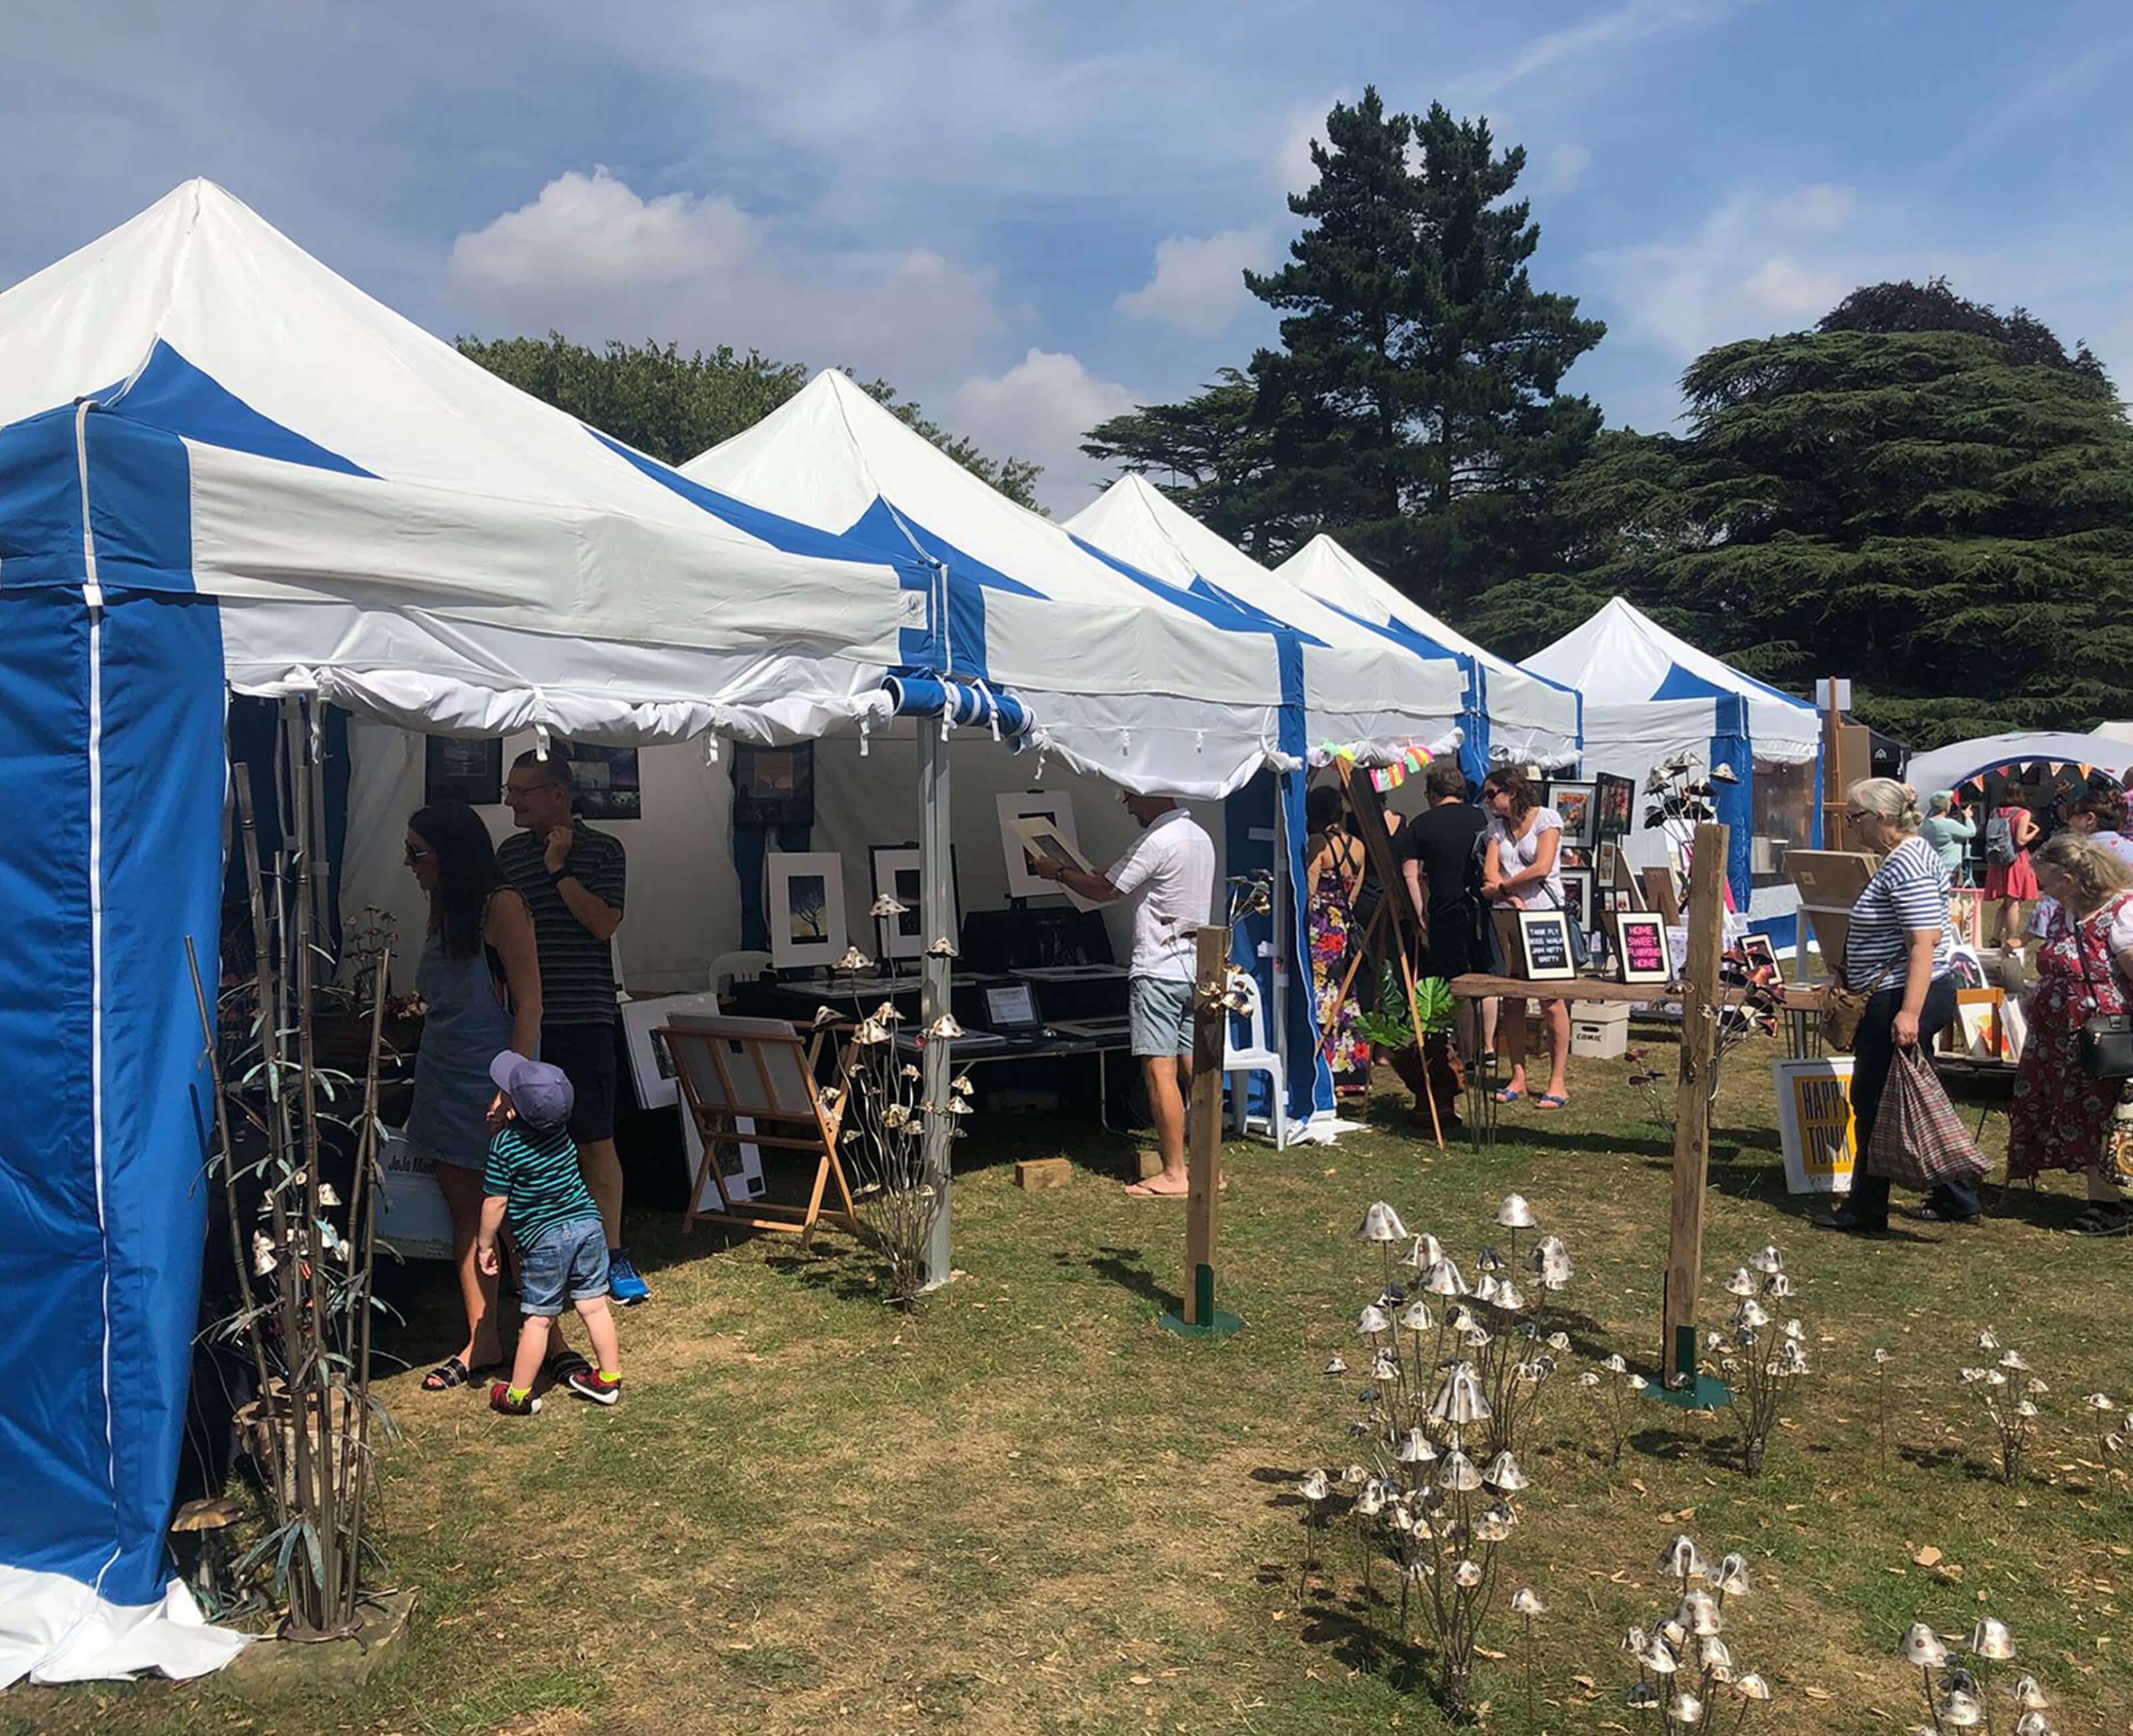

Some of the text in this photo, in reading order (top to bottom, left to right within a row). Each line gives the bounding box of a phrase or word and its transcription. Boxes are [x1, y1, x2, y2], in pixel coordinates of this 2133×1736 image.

[1628, 925, 1653, 935] HOME
[1627, 937, 1658, 946] SWEET
[1632, 958, 1658, 968] HOME
[1802, 1081, 1850, 1119] HAPPY
[1807, 1125, 1851, 1163] TOWN
